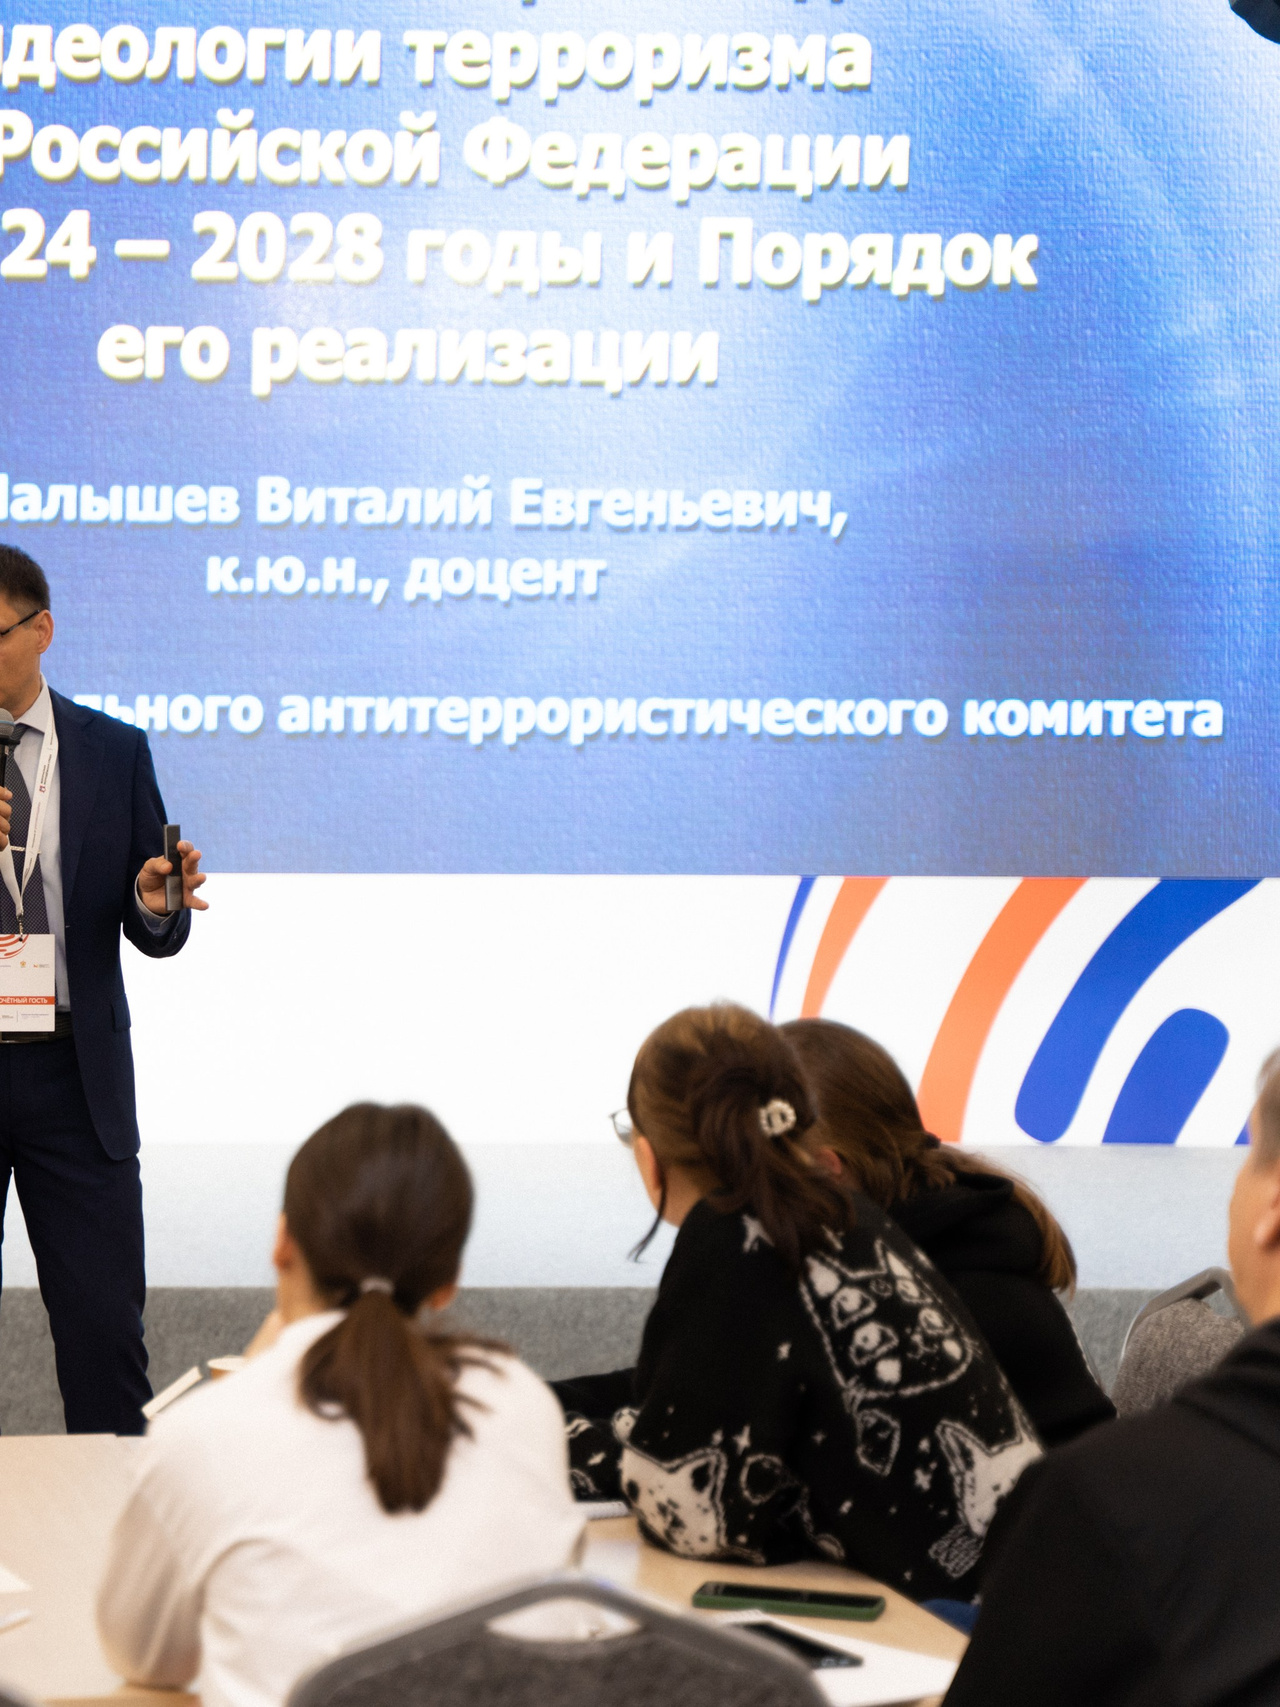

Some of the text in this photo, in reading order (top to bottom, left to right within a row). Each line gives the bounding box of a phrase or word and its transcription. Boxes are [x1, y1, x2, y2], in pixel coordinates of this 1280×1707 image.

[404, 31, 872, 102] терроризма
[463, 116, 911, 203] Федерации
[191, 211, 384, 283] 2028
[406, 229, 602, 295] годы
[627, 232, 674, 284] и
[700, 217, 1039, 300] Порядок
[97, 325, 720, 397] его реализации
[255, 476, 493, 527] Виталий
[509, 479, 848, 537] Евгеньевич,
[206, 554, 607, 603] к.ю.н., доцент
[277, 694, 949, 744] антитеррористического
[963, 698, 1224, 739] комитета
